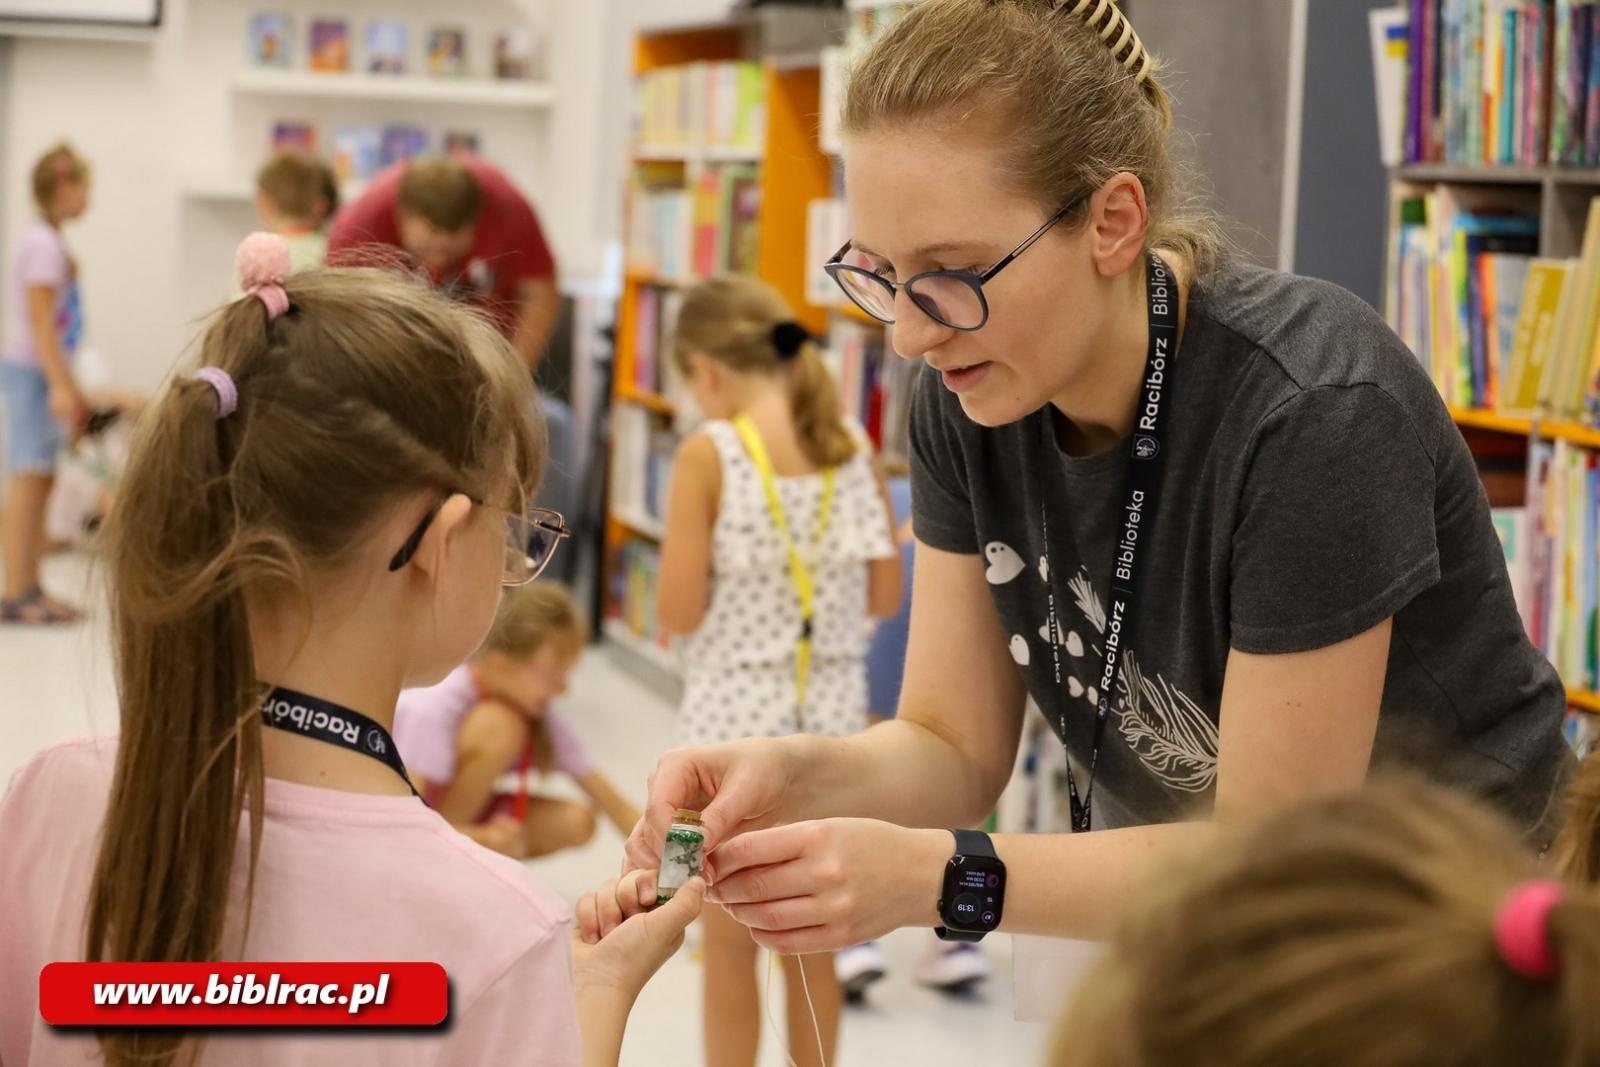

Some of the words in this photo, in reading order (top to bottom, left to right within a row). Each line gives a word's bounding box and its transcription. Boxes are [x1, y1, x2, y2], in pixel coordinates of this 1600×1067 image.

[1151, 250, 1169, 315] Bibliote
[1139, 337, 1168, 431] Racibórz
[1100, 600, 1126, 692] Racibórz
[1115, 490, 1145, 581] Biblioteka
[260, 698, 361, 745] Racibór
[957, 903, 975, 912] 13:19
